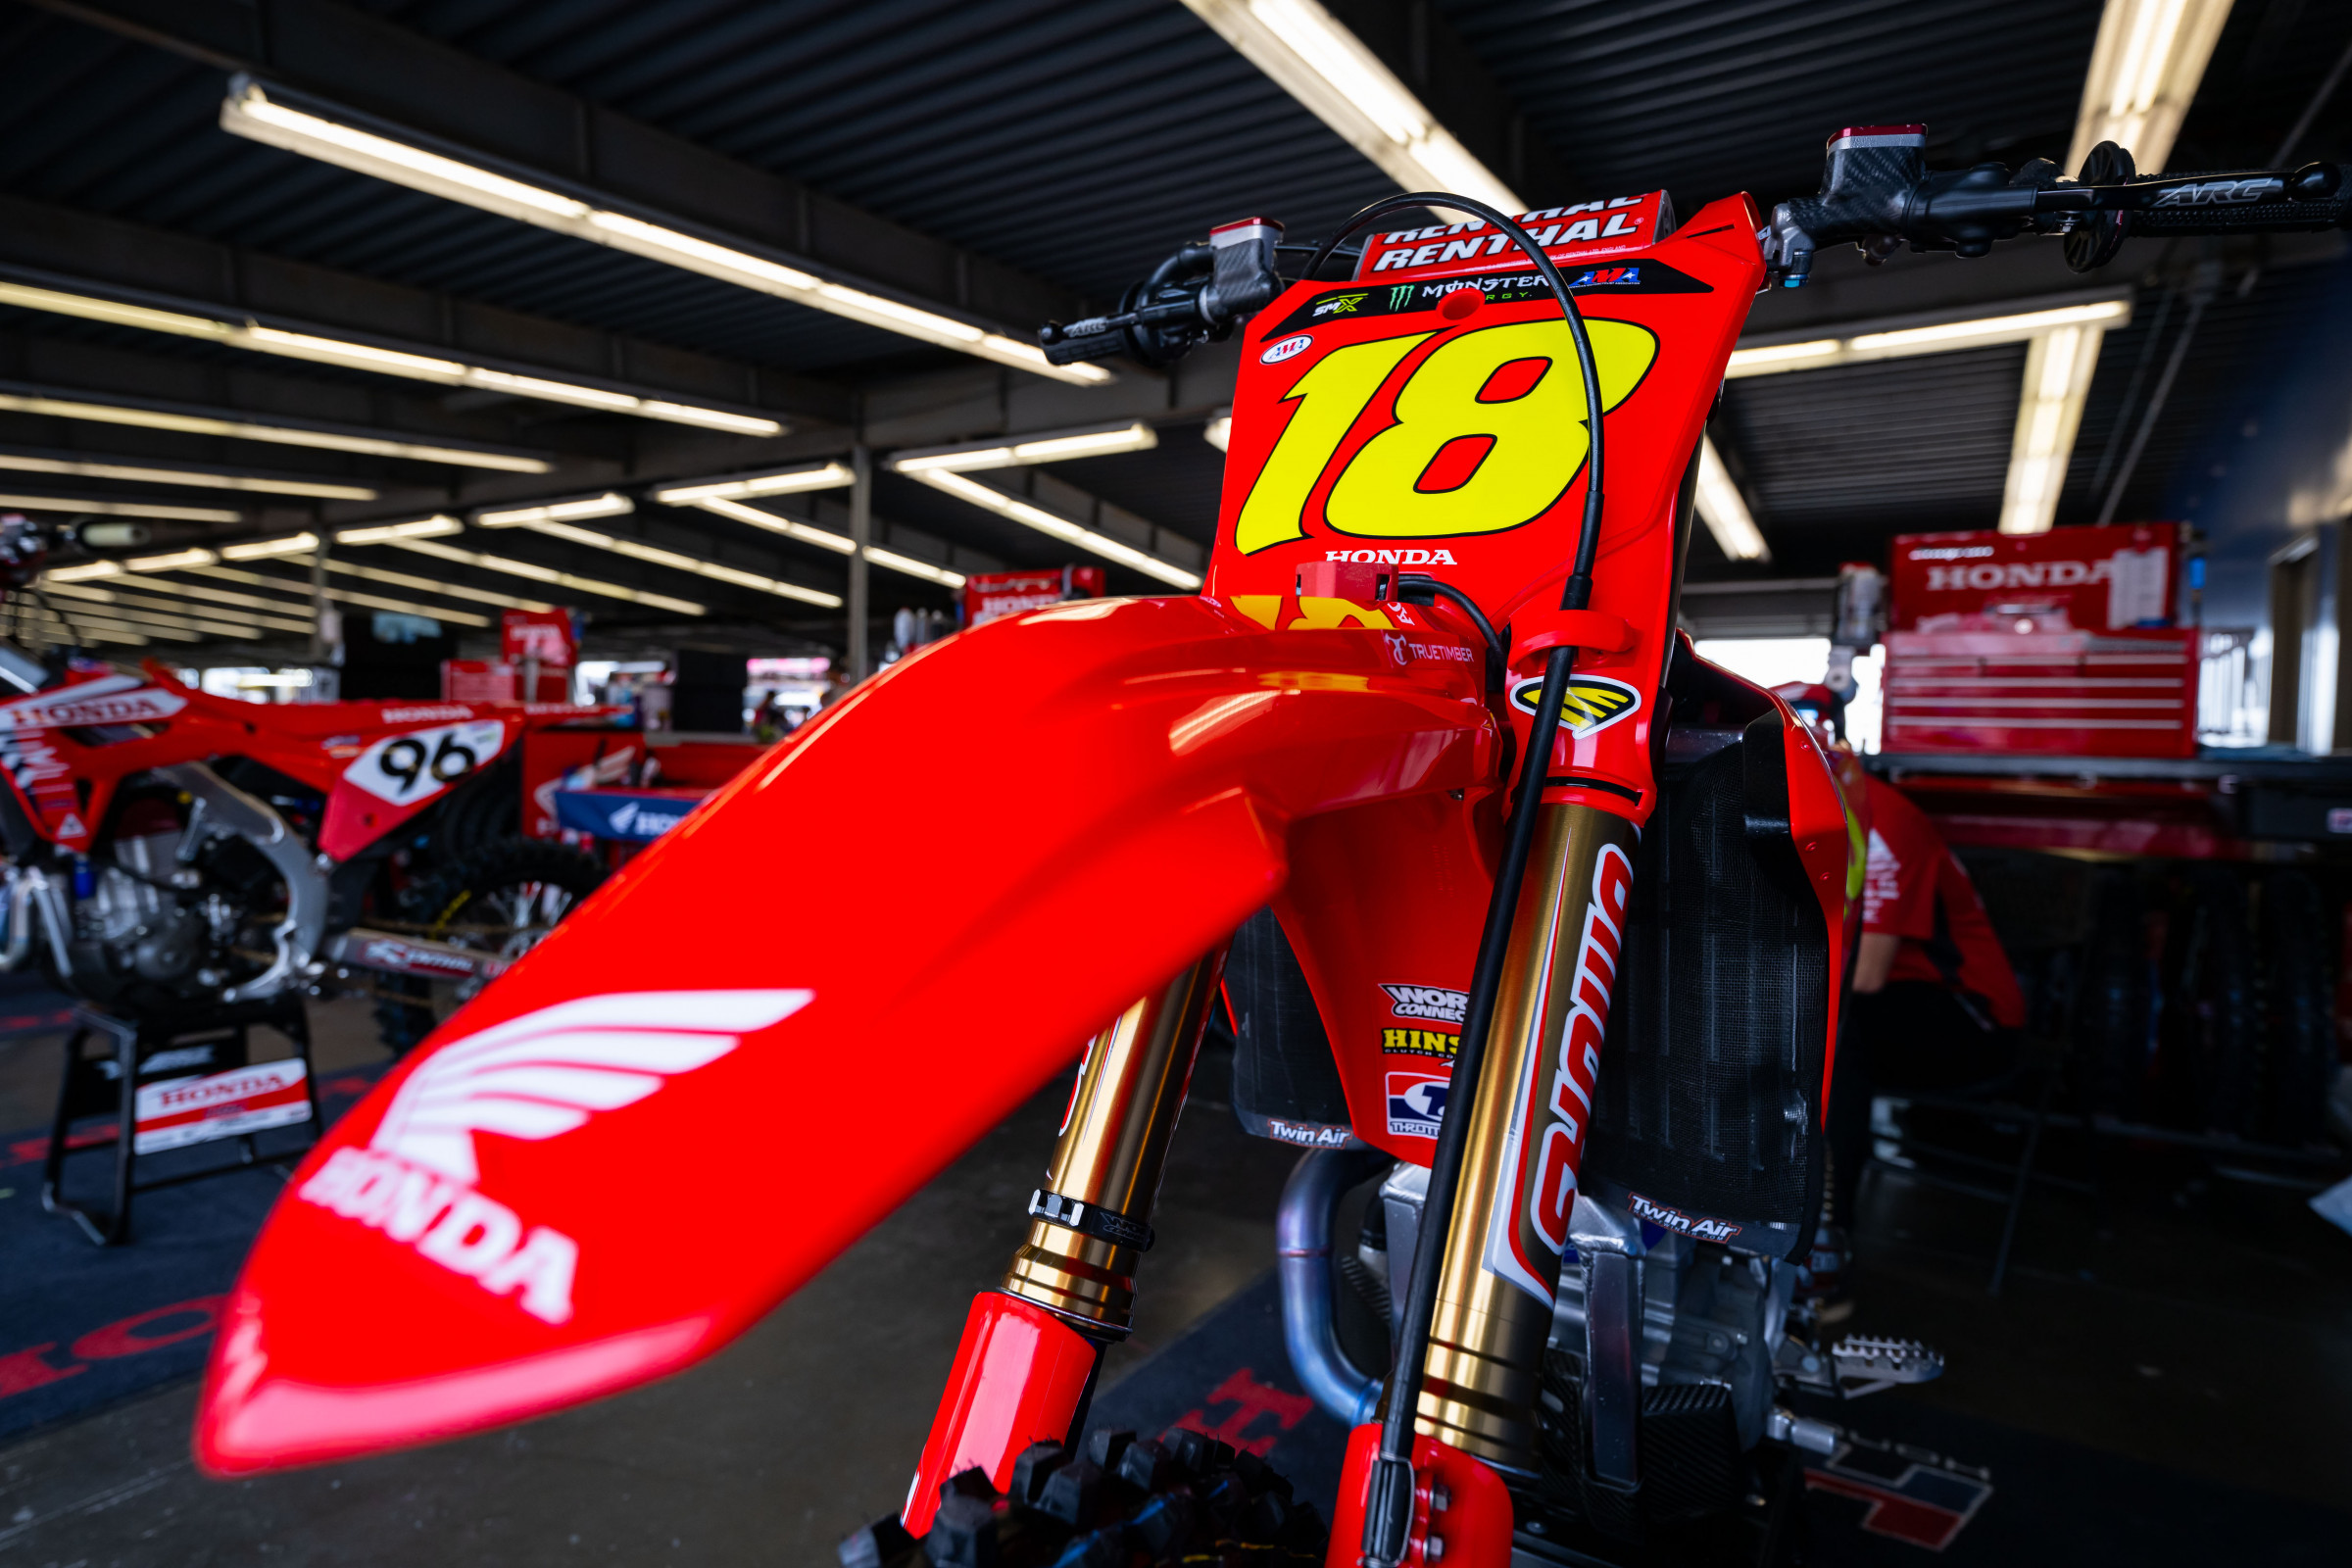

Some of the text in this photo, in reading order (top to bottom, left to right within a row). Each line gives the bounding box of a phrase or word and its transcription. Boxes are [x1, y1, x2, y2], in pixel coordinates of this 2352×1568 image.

[2150, 177, 2274, 208] ARC
[1382, 196, 1643, 244] RENHAL
[1372, 212, 1639, 271] RENTHAL
[1568, 268, 1641, 287] AMA
[1267, 339, 1305, 361] AMA
[1234, 317, 1660, 557] 18
[1325, 549, 1458, 565] HONDA
[1927, 560, 2114, 591] HONDA
[1408, 643, 1475, 662] TRUETIMBER
[12, 699, 161, 726] HONDA
[379, 732, 476, 796] 96
[1387, 987, 1469, 1010] WOR
[1395, 1004, 1466, 1022] CONNEC
[1383, 1029, 1460, 1054] HINS
[161, 1073, 284, 1107] HONDA
[1270, 1120, 1316, 1143] Twin
[1316, 1128, 1350, 1144] Air
[1392, 1121, 1440, 1137] THROTT
[1632, 1195, 1738, 1237] Twin Air
[298, 1145, 579, 1326] HONDA
